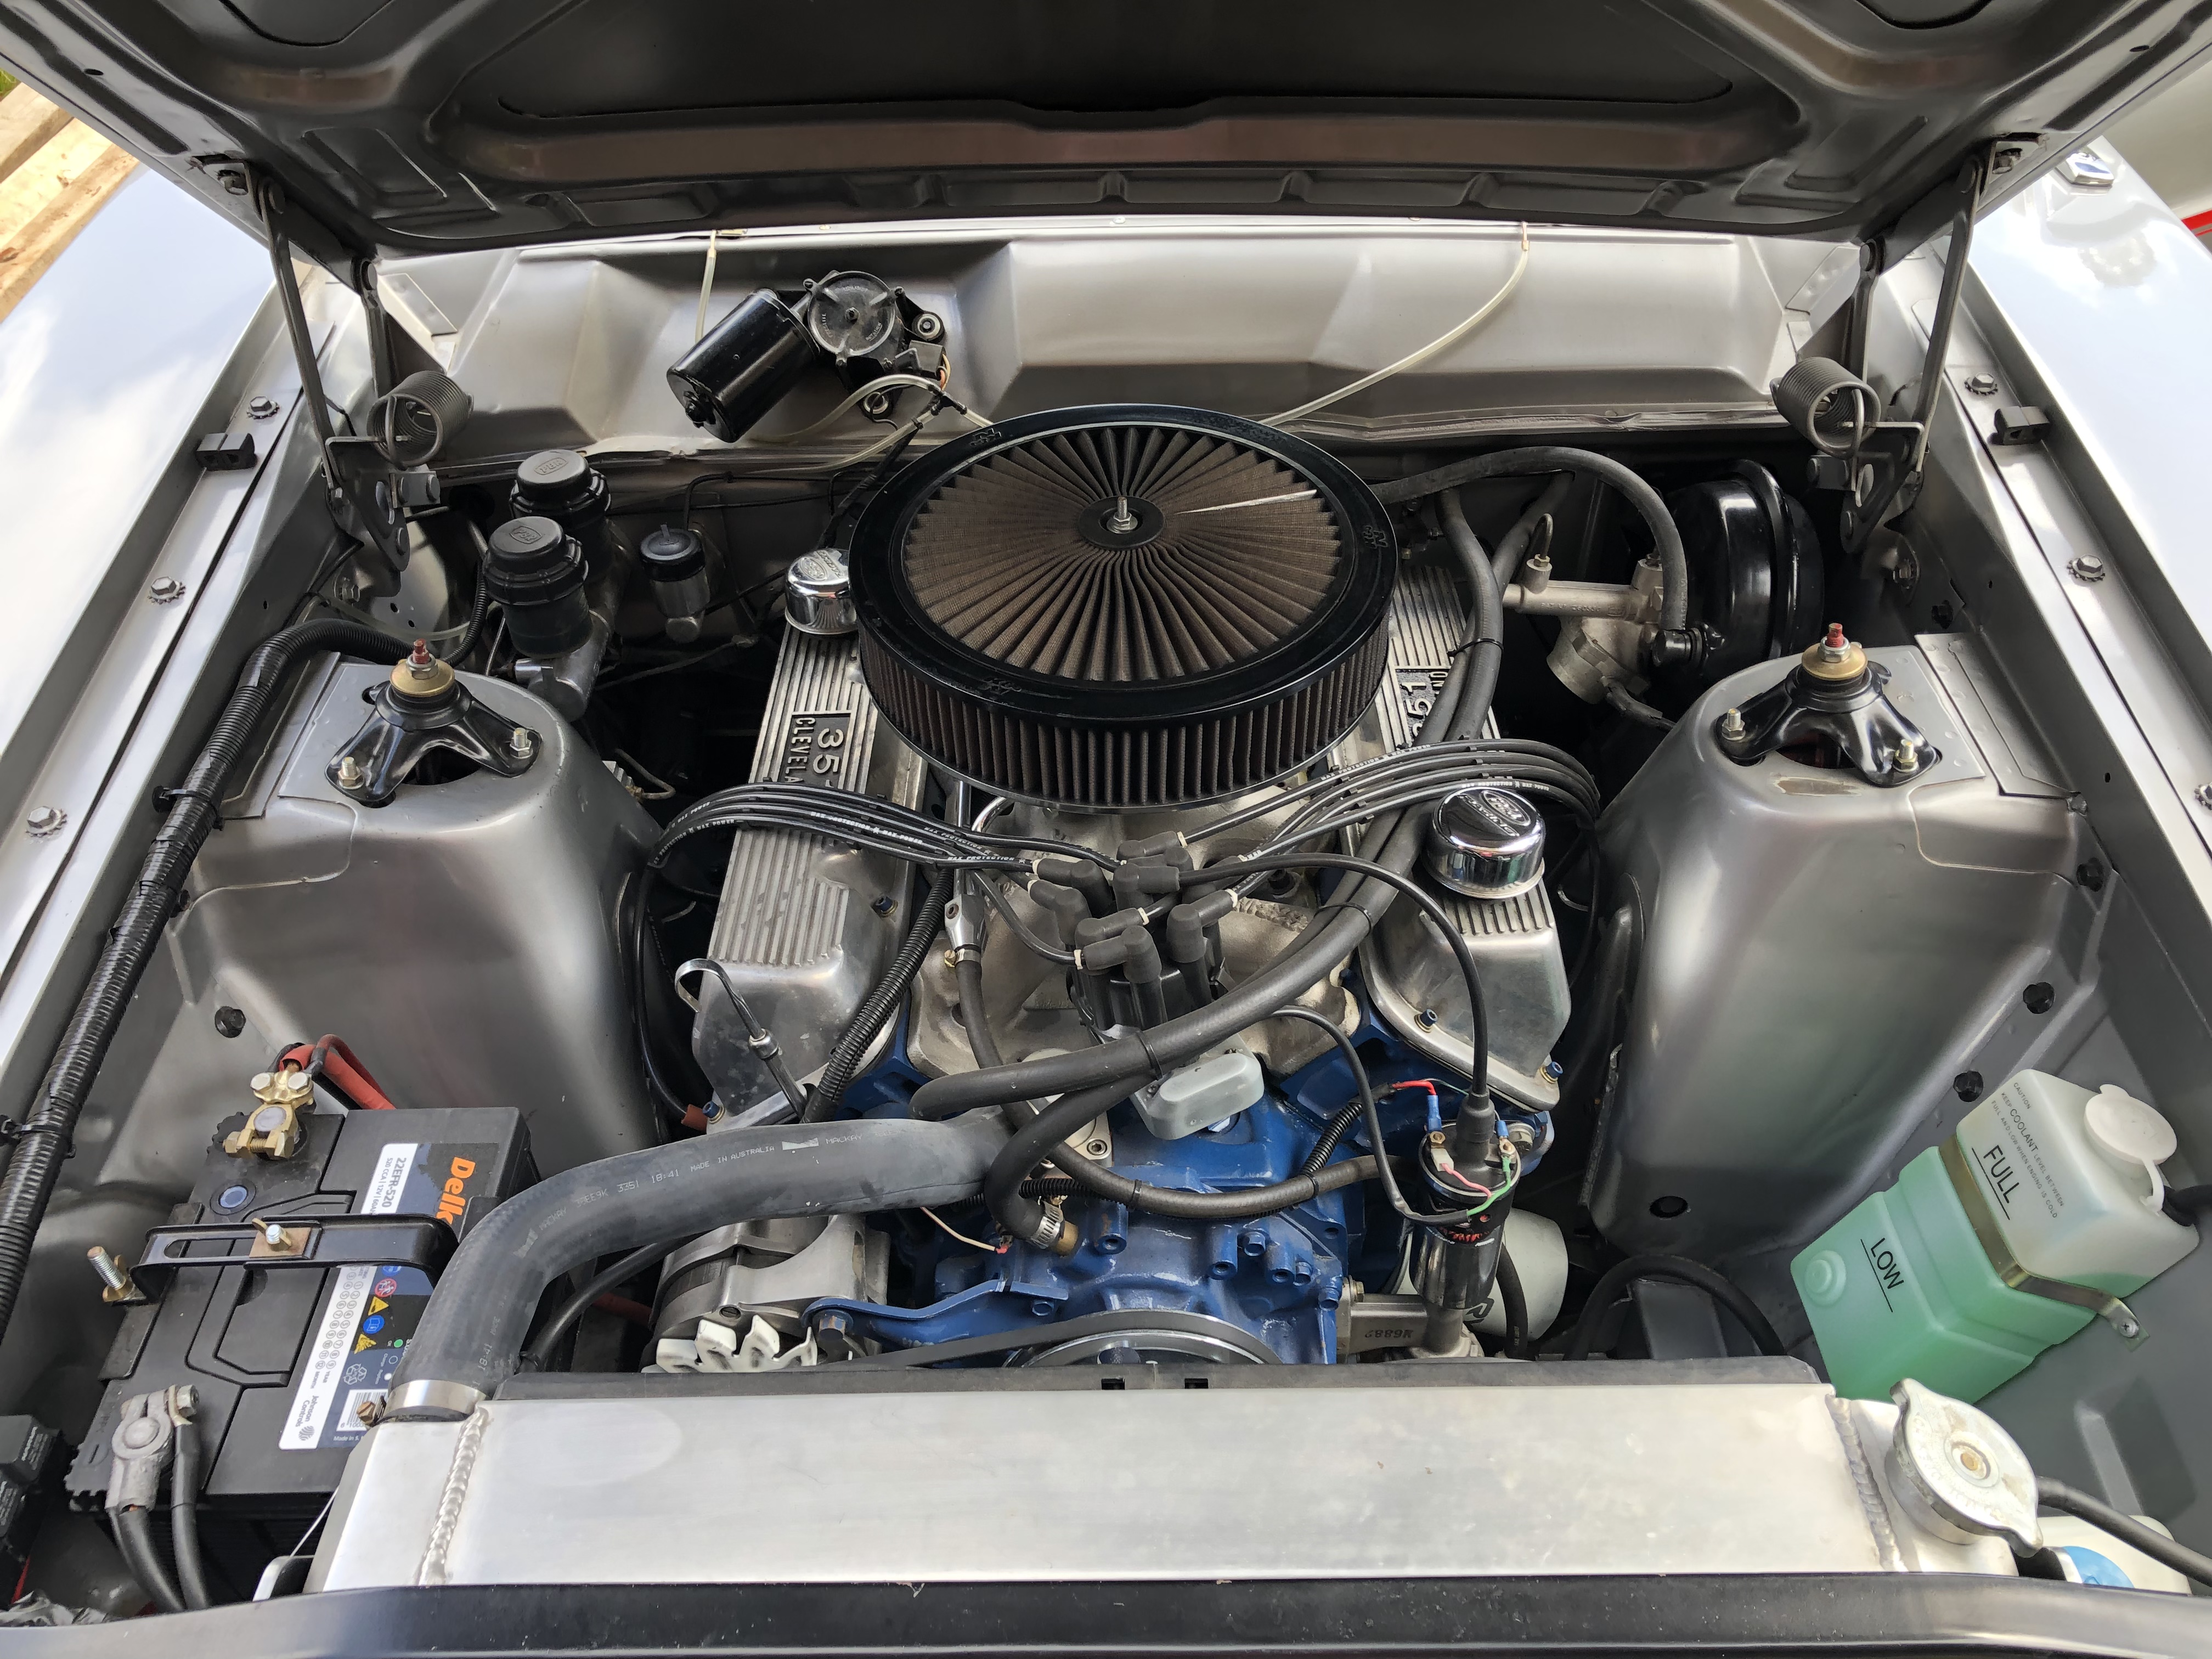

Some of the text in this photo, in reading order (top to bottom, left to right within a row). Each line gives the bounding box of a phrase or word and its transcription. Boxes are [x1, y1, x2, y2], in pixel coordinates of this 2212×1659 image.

[1338, 757, 1380, 774] PROTECTION
[827, 816, 871, 830] PROTECTION
[659, 832, 687, 856] PROTECTION
[941, 832, 983, 850] PROTECTION
[2013, 1082, 2031, 1109] CAUTION
[385, 1158, 393, 1167] 520
[651, 1169, 680, 1183] 18:41
[690, 1160, 710, 1172] MADE
[718, 1155, 727, 1164] IN
[730, 1146, 775, 1160] AUSTRALIA
[826, 1133, 862, 1144] MACKAY
[2001, 1092, 2064, 1206] KEEP COOLANT LEVEL BETWEEN
[380, 1168, 391, 1180] CCA
[381, 1157, 407, 1207] 22EFR-520
[1983, 1144, 2020, 1204] FULL
[2016, 1146, 2029, 1164] WHEN
[2046, 1199, 2058, 1218] COLD
[376, 1184, 384, 1195] 12V
[1870, 1237, 1904, 1290] LOW
[295, 1400, 310, 1427] Controls
[304, 1395, 319, 1422] Johnson
